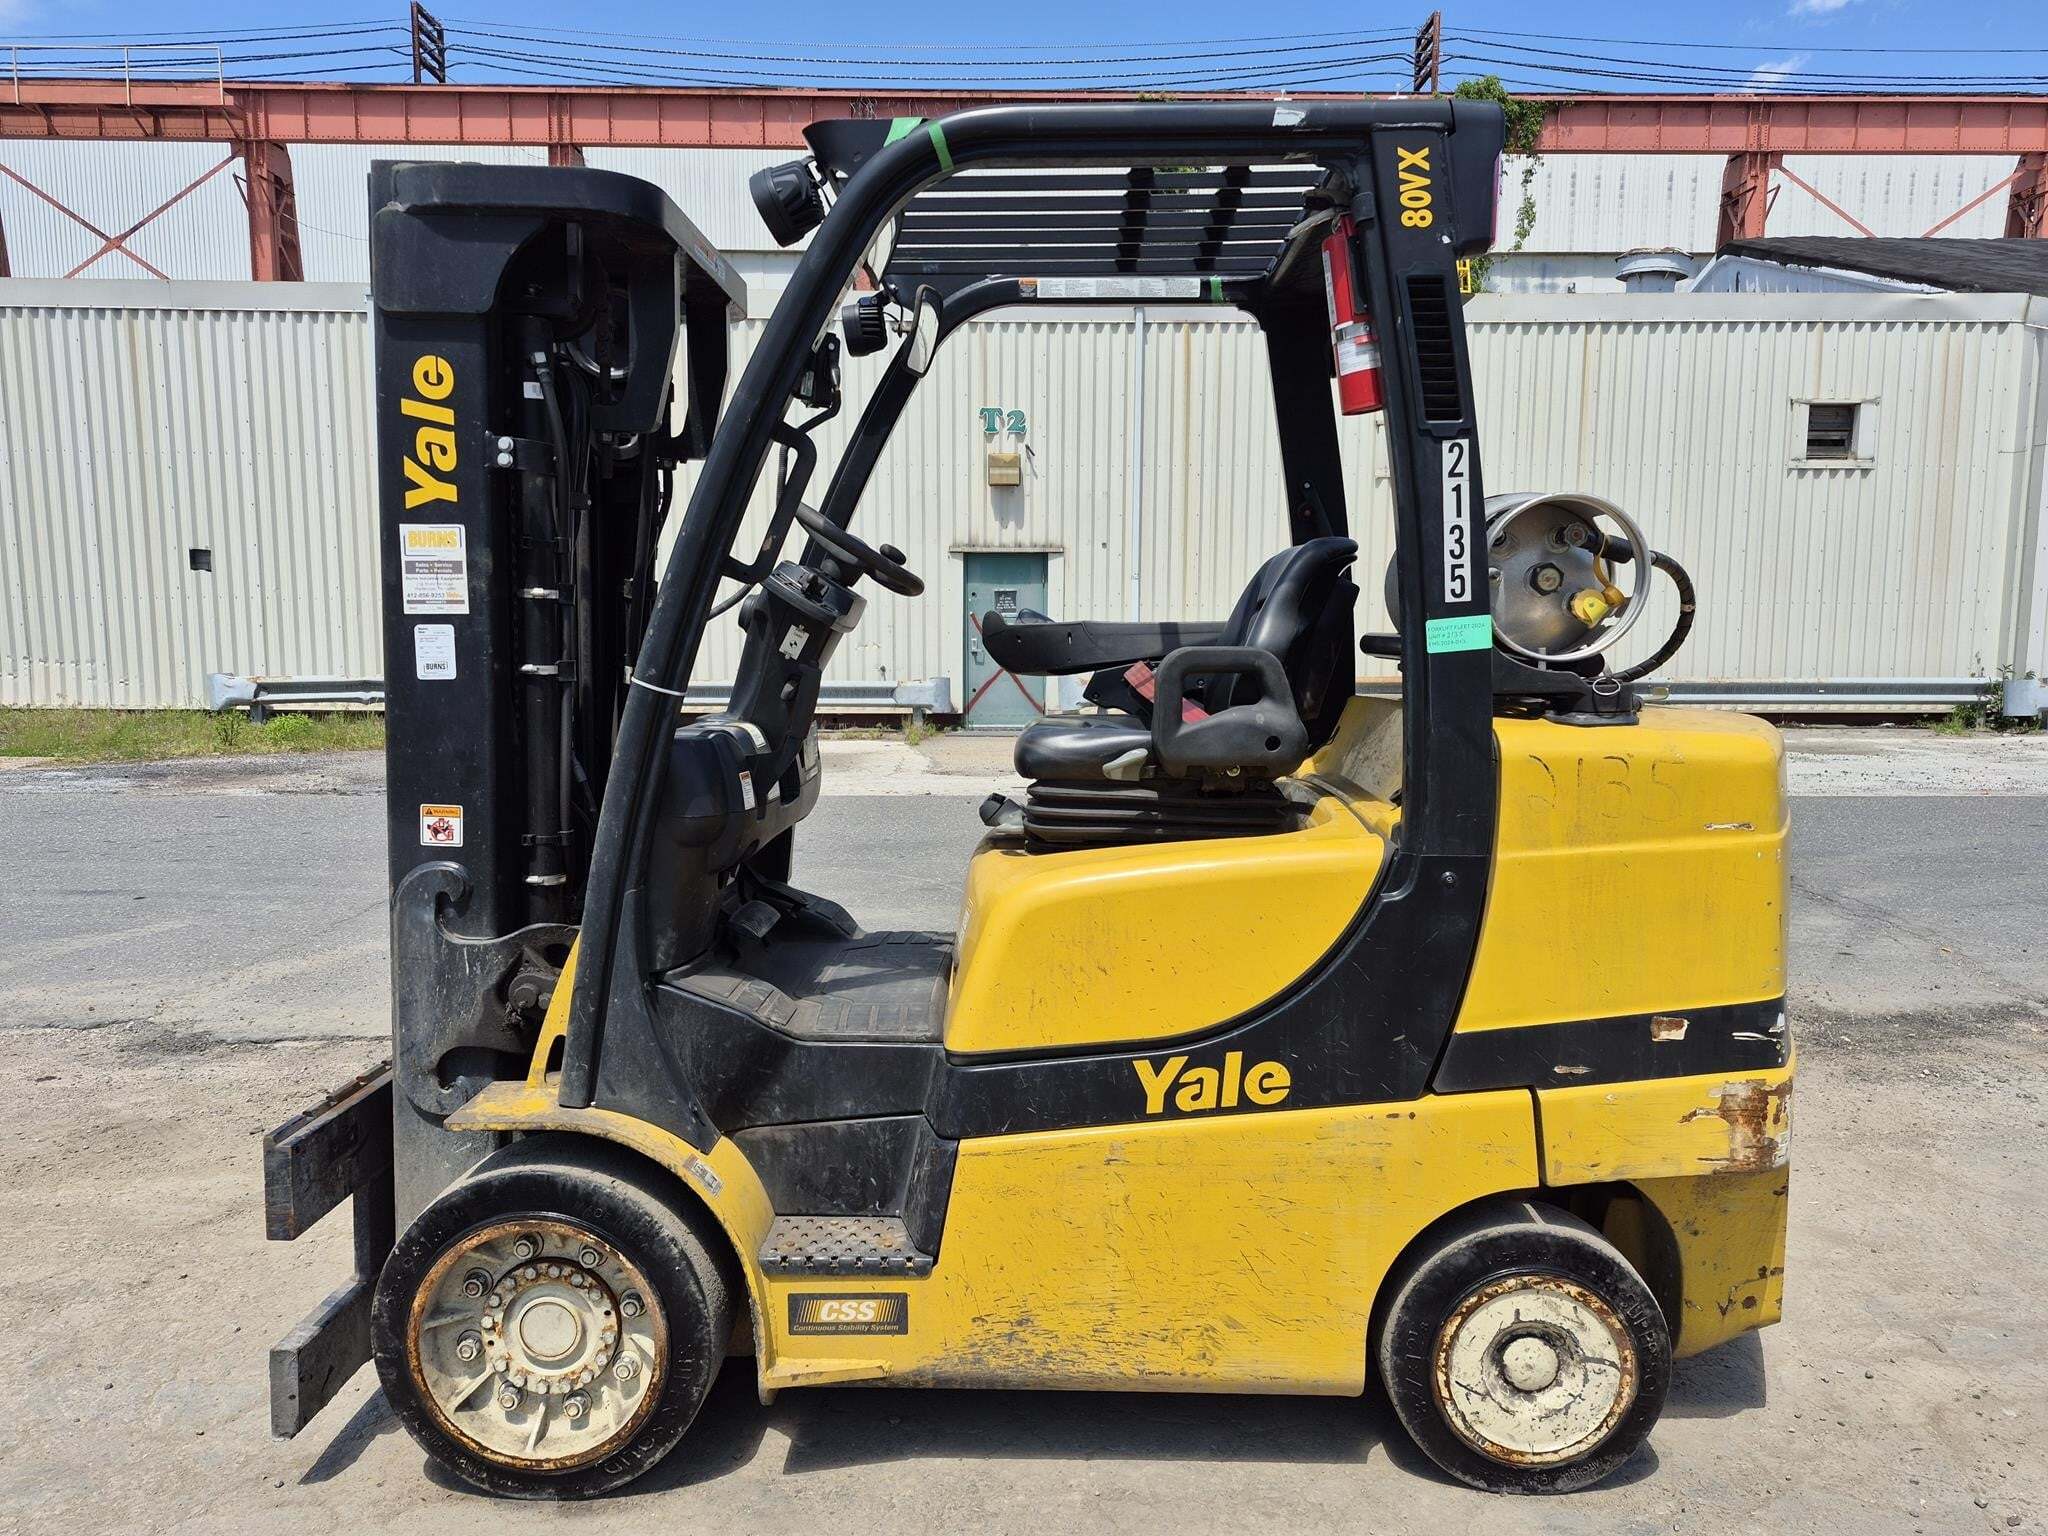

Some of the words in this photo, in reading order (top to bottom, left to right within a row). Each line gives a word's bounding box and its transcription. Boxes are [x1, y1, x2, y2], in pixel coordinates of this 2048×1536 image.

[1397, 147, 1433, 228] 80VX
[401, 355, 458, 510] Yale
[408, 530, 458, 547] BURNS
[1448, 442, 1466, 598] 2135
[425, 662, 446, 671] BURNS
[1132, 1051, 1291, 1114] Yale
[820, 1301, 877, 1321] CSS
[838, 1324, 869, 1332] Stability
[871, 1323, 899, 1331] System
